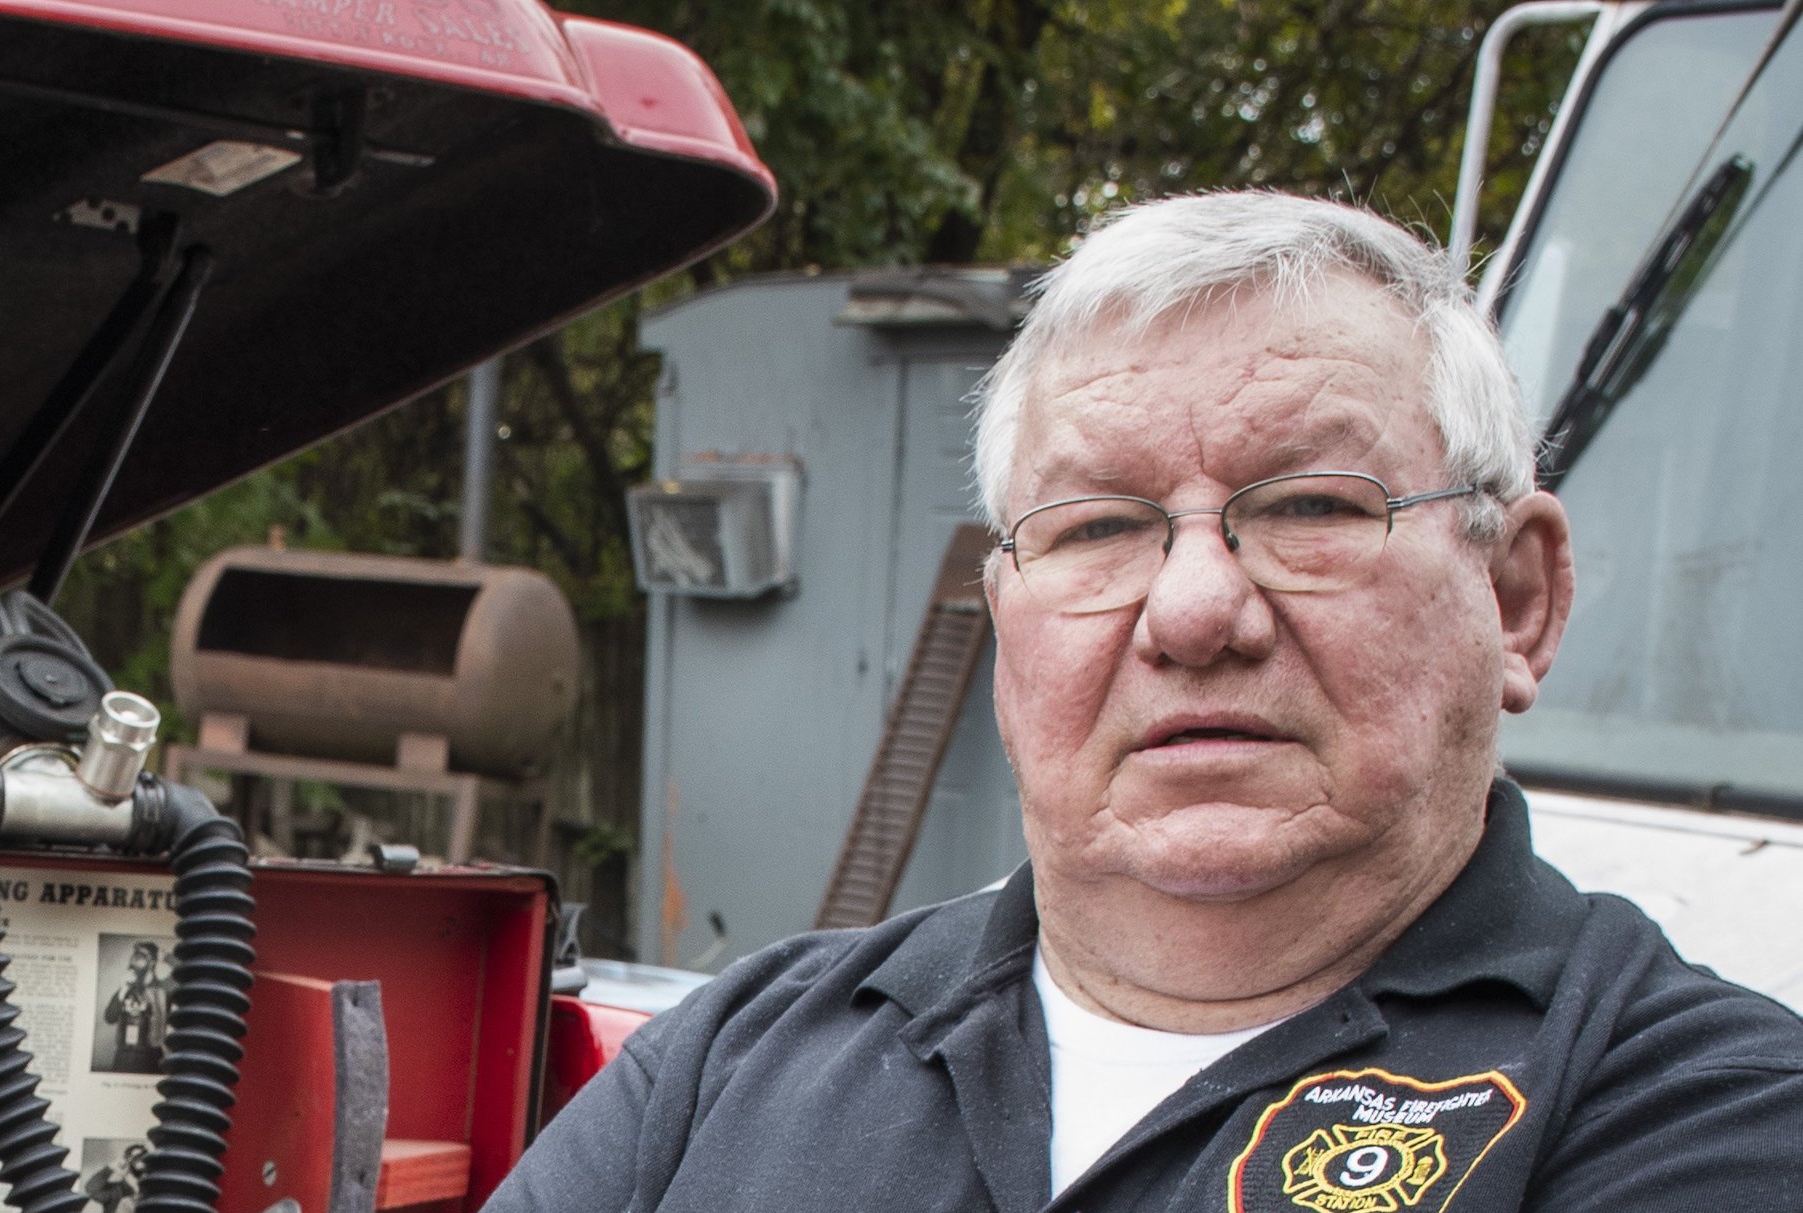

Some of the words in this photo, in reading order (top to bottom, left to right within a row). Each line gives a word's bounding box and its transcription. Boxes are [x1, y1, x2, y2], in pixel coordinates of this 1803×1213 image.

[416, 6, 534, 54] SALES
[39, 881, 177, 912] APPARATU
[1304, 1083, 1395, 1112] ARKANSAS
[1352, 1105, 1437, 1125] MUSEUM
[1354, 1128, 1408, 1142] FIRE
[1339, 1146, 1389, 1188] 9
[1315, 1194, 1378, 1210] STATION
